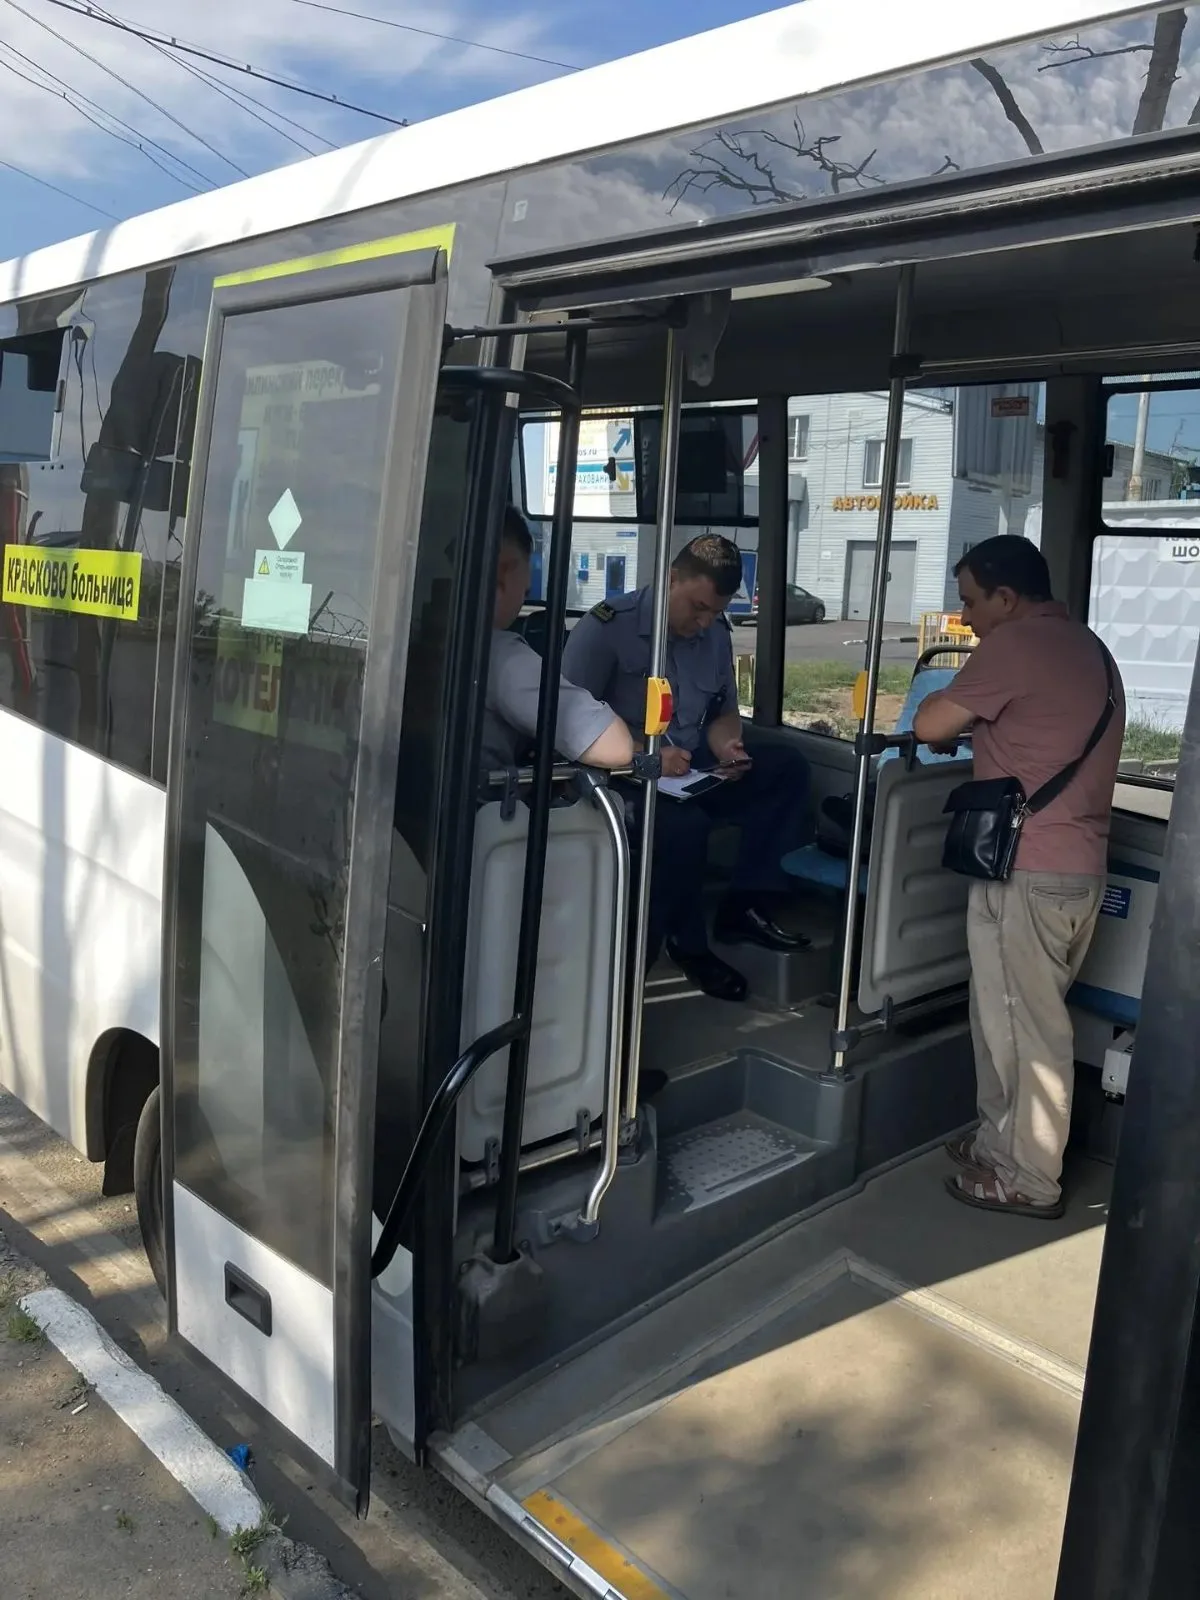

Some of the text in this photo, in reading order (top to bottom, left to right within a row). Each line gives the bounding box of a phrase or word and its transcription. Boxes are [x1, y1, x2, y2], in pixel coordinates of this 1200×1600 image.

[832, 491, 939, 511] АВТООЙКА
[7, 556, 134, 614] КРАСКОВО больница
